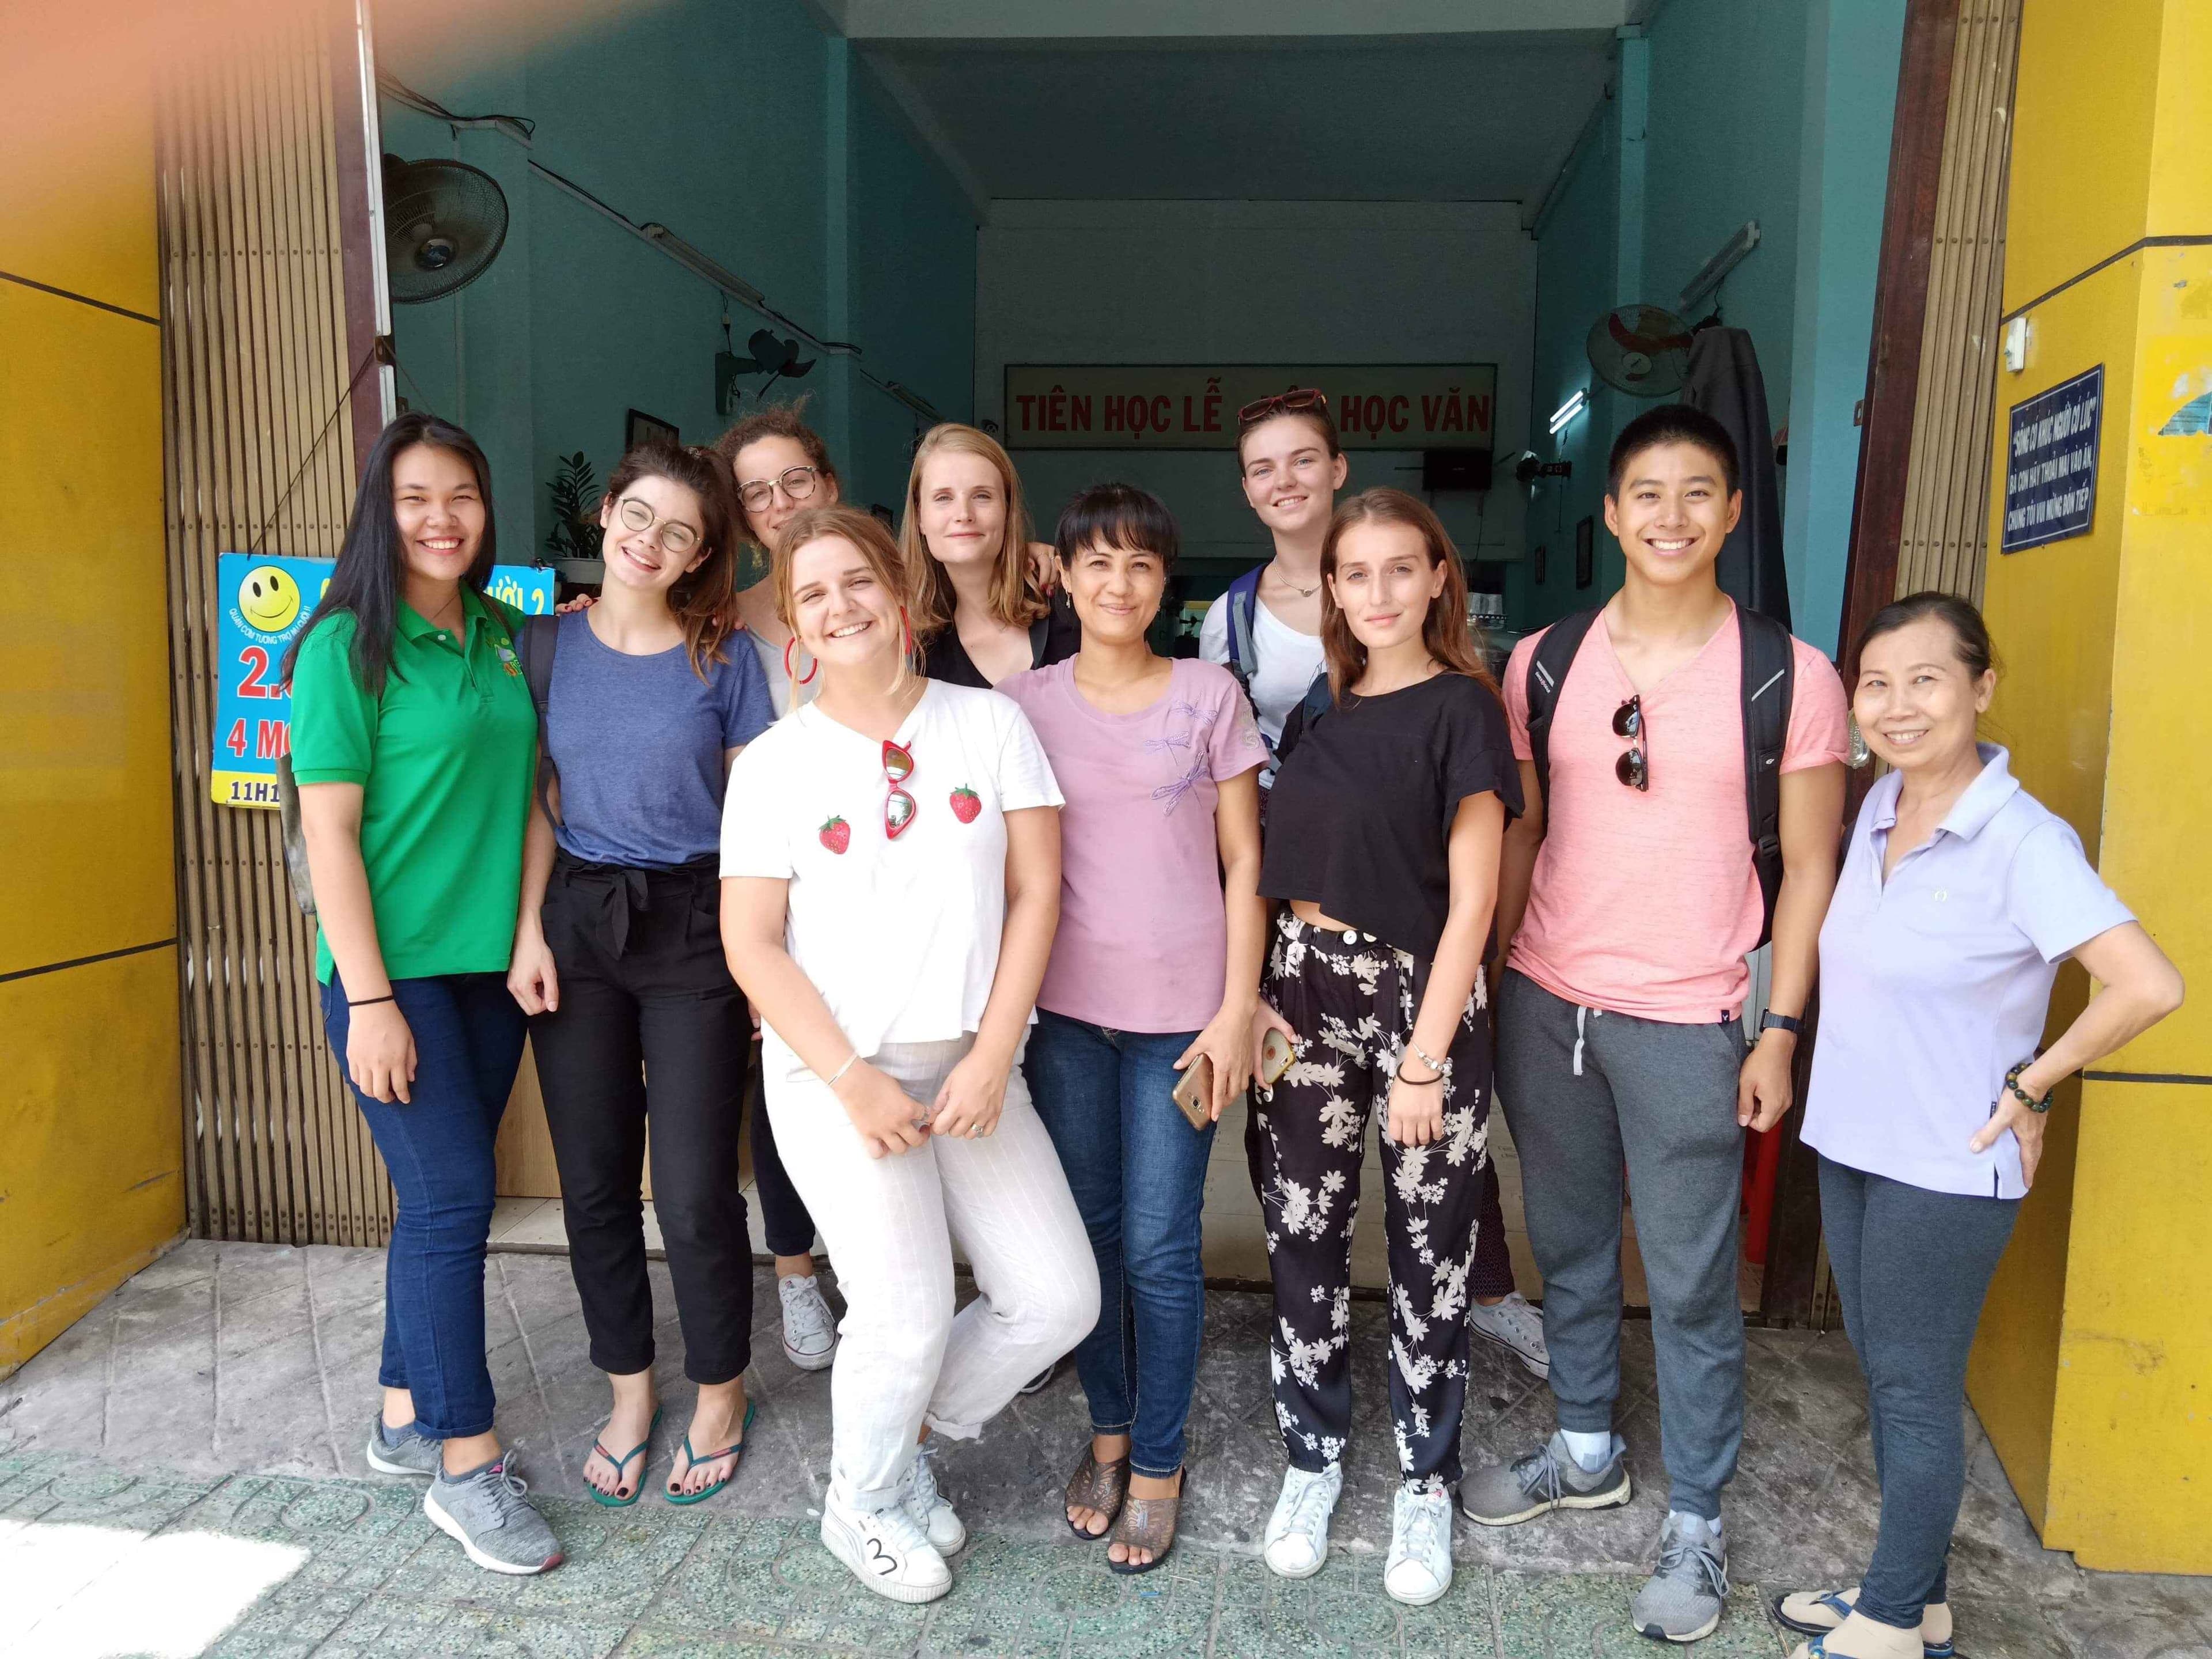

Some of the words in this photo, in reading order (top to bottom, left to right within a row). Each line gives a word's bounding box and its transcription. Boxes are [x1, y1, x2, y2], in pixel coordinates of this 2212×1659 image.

[1016, 385, 1092, 431] TIÊN
[1104, 395, 1172, 440] HỌC
[1183, 377, 1222, 432] LỄ
[1340, 395, 1410, 440] HỌC
[1421, 387, 1490, 432] VĂN
[2029, 415, 2039, 452] CÓ
[2037, 410, 2054, 448] KHÚC
[2071, 396, 2081, 435] CÓ
[2009, 468, 2017, 495] BÀ
[2018, 469, 2029, 492] CON
[2029, 461, 2041, 488] HÃY
[2058, 448, 2070, 478] MÁI
[2070, 445, 2082, 474] VÀO
[2008, 503, 2026, 532] CHÚNG
[2027, 499, 2036, 527] TÔI
[2036, 501, 2046, 524] VUI
[2046, 492, 2063, 521] MỪNG
[2075, 478, 2089, 512] TIẾP
[532, 588, 544, 615] 2
[226, 718, 247, 758] 4
